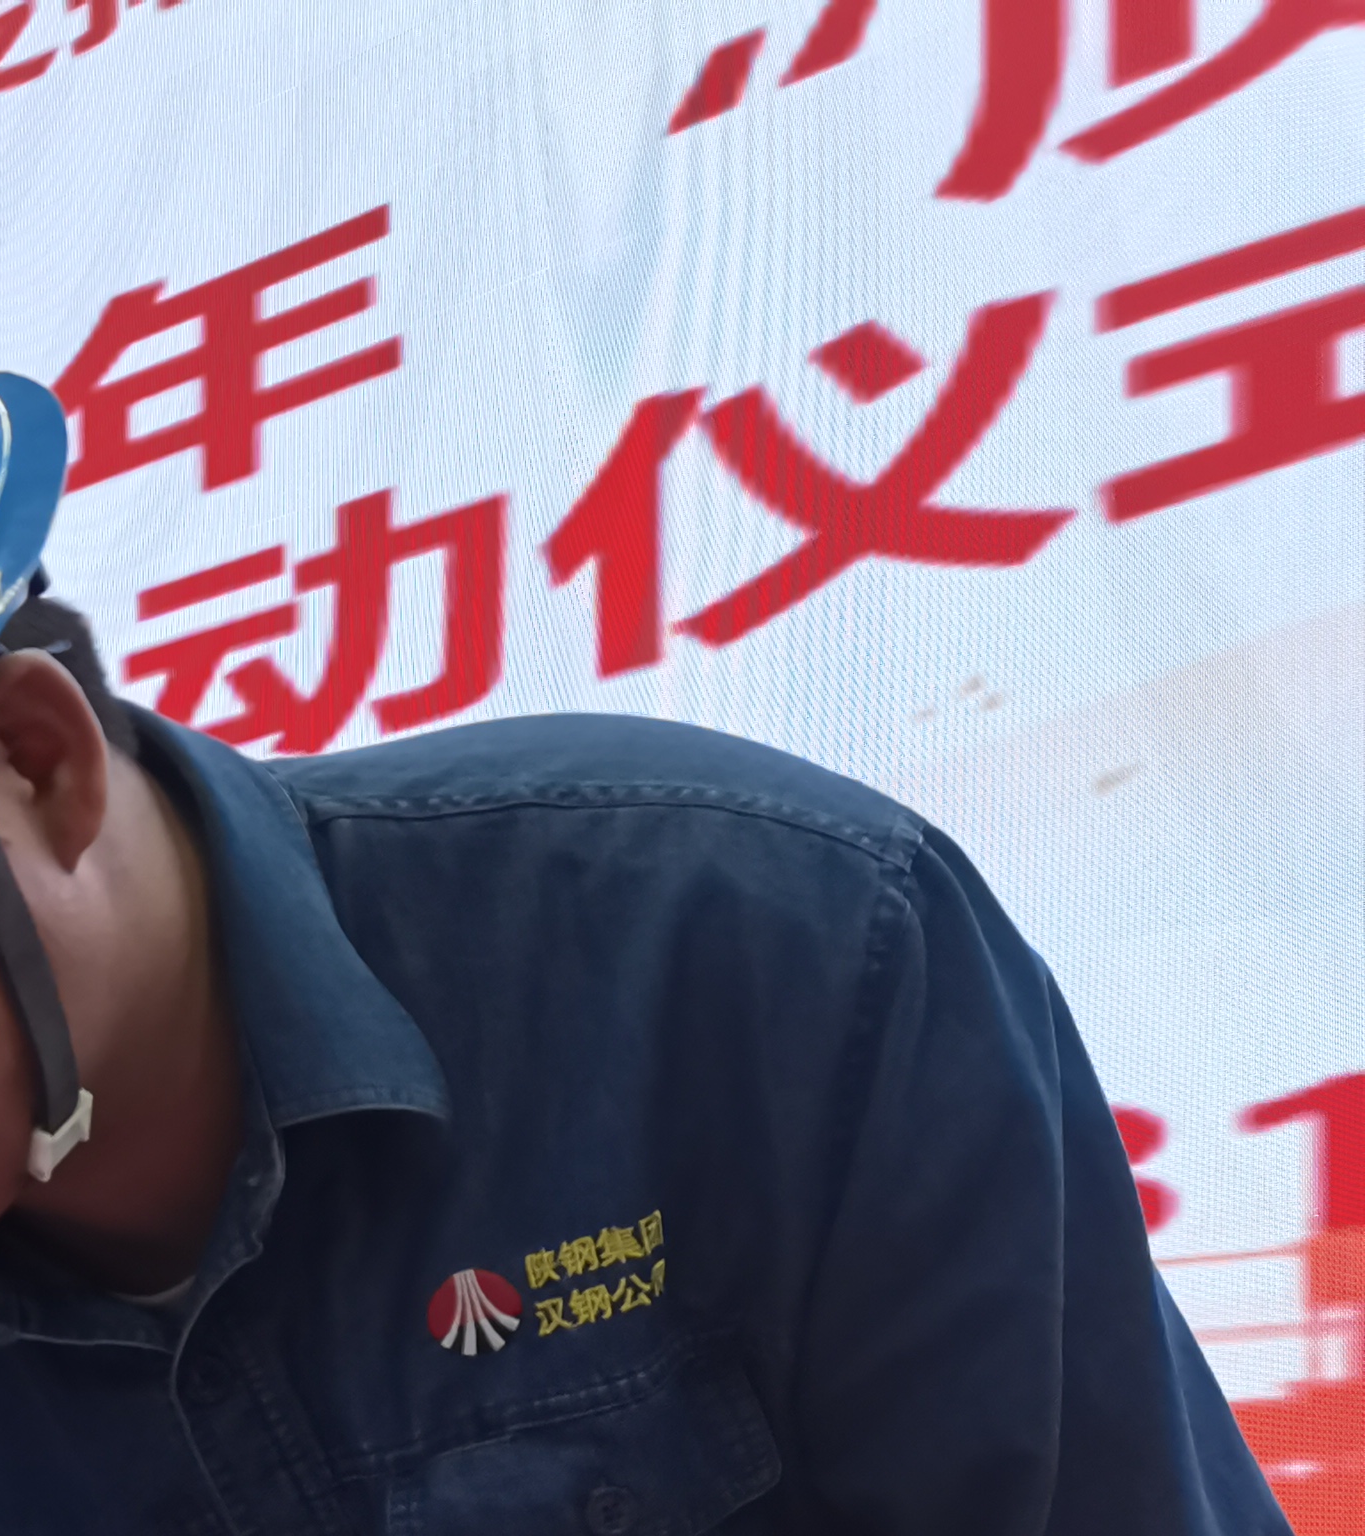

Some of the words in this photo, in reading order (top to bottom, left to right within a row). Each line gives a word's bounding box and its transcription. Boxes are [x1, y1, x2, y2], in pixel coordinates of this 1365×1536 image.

[54, 202, 403, 494] 年
[524, 1209, 665, 1290] 陕钢集团
